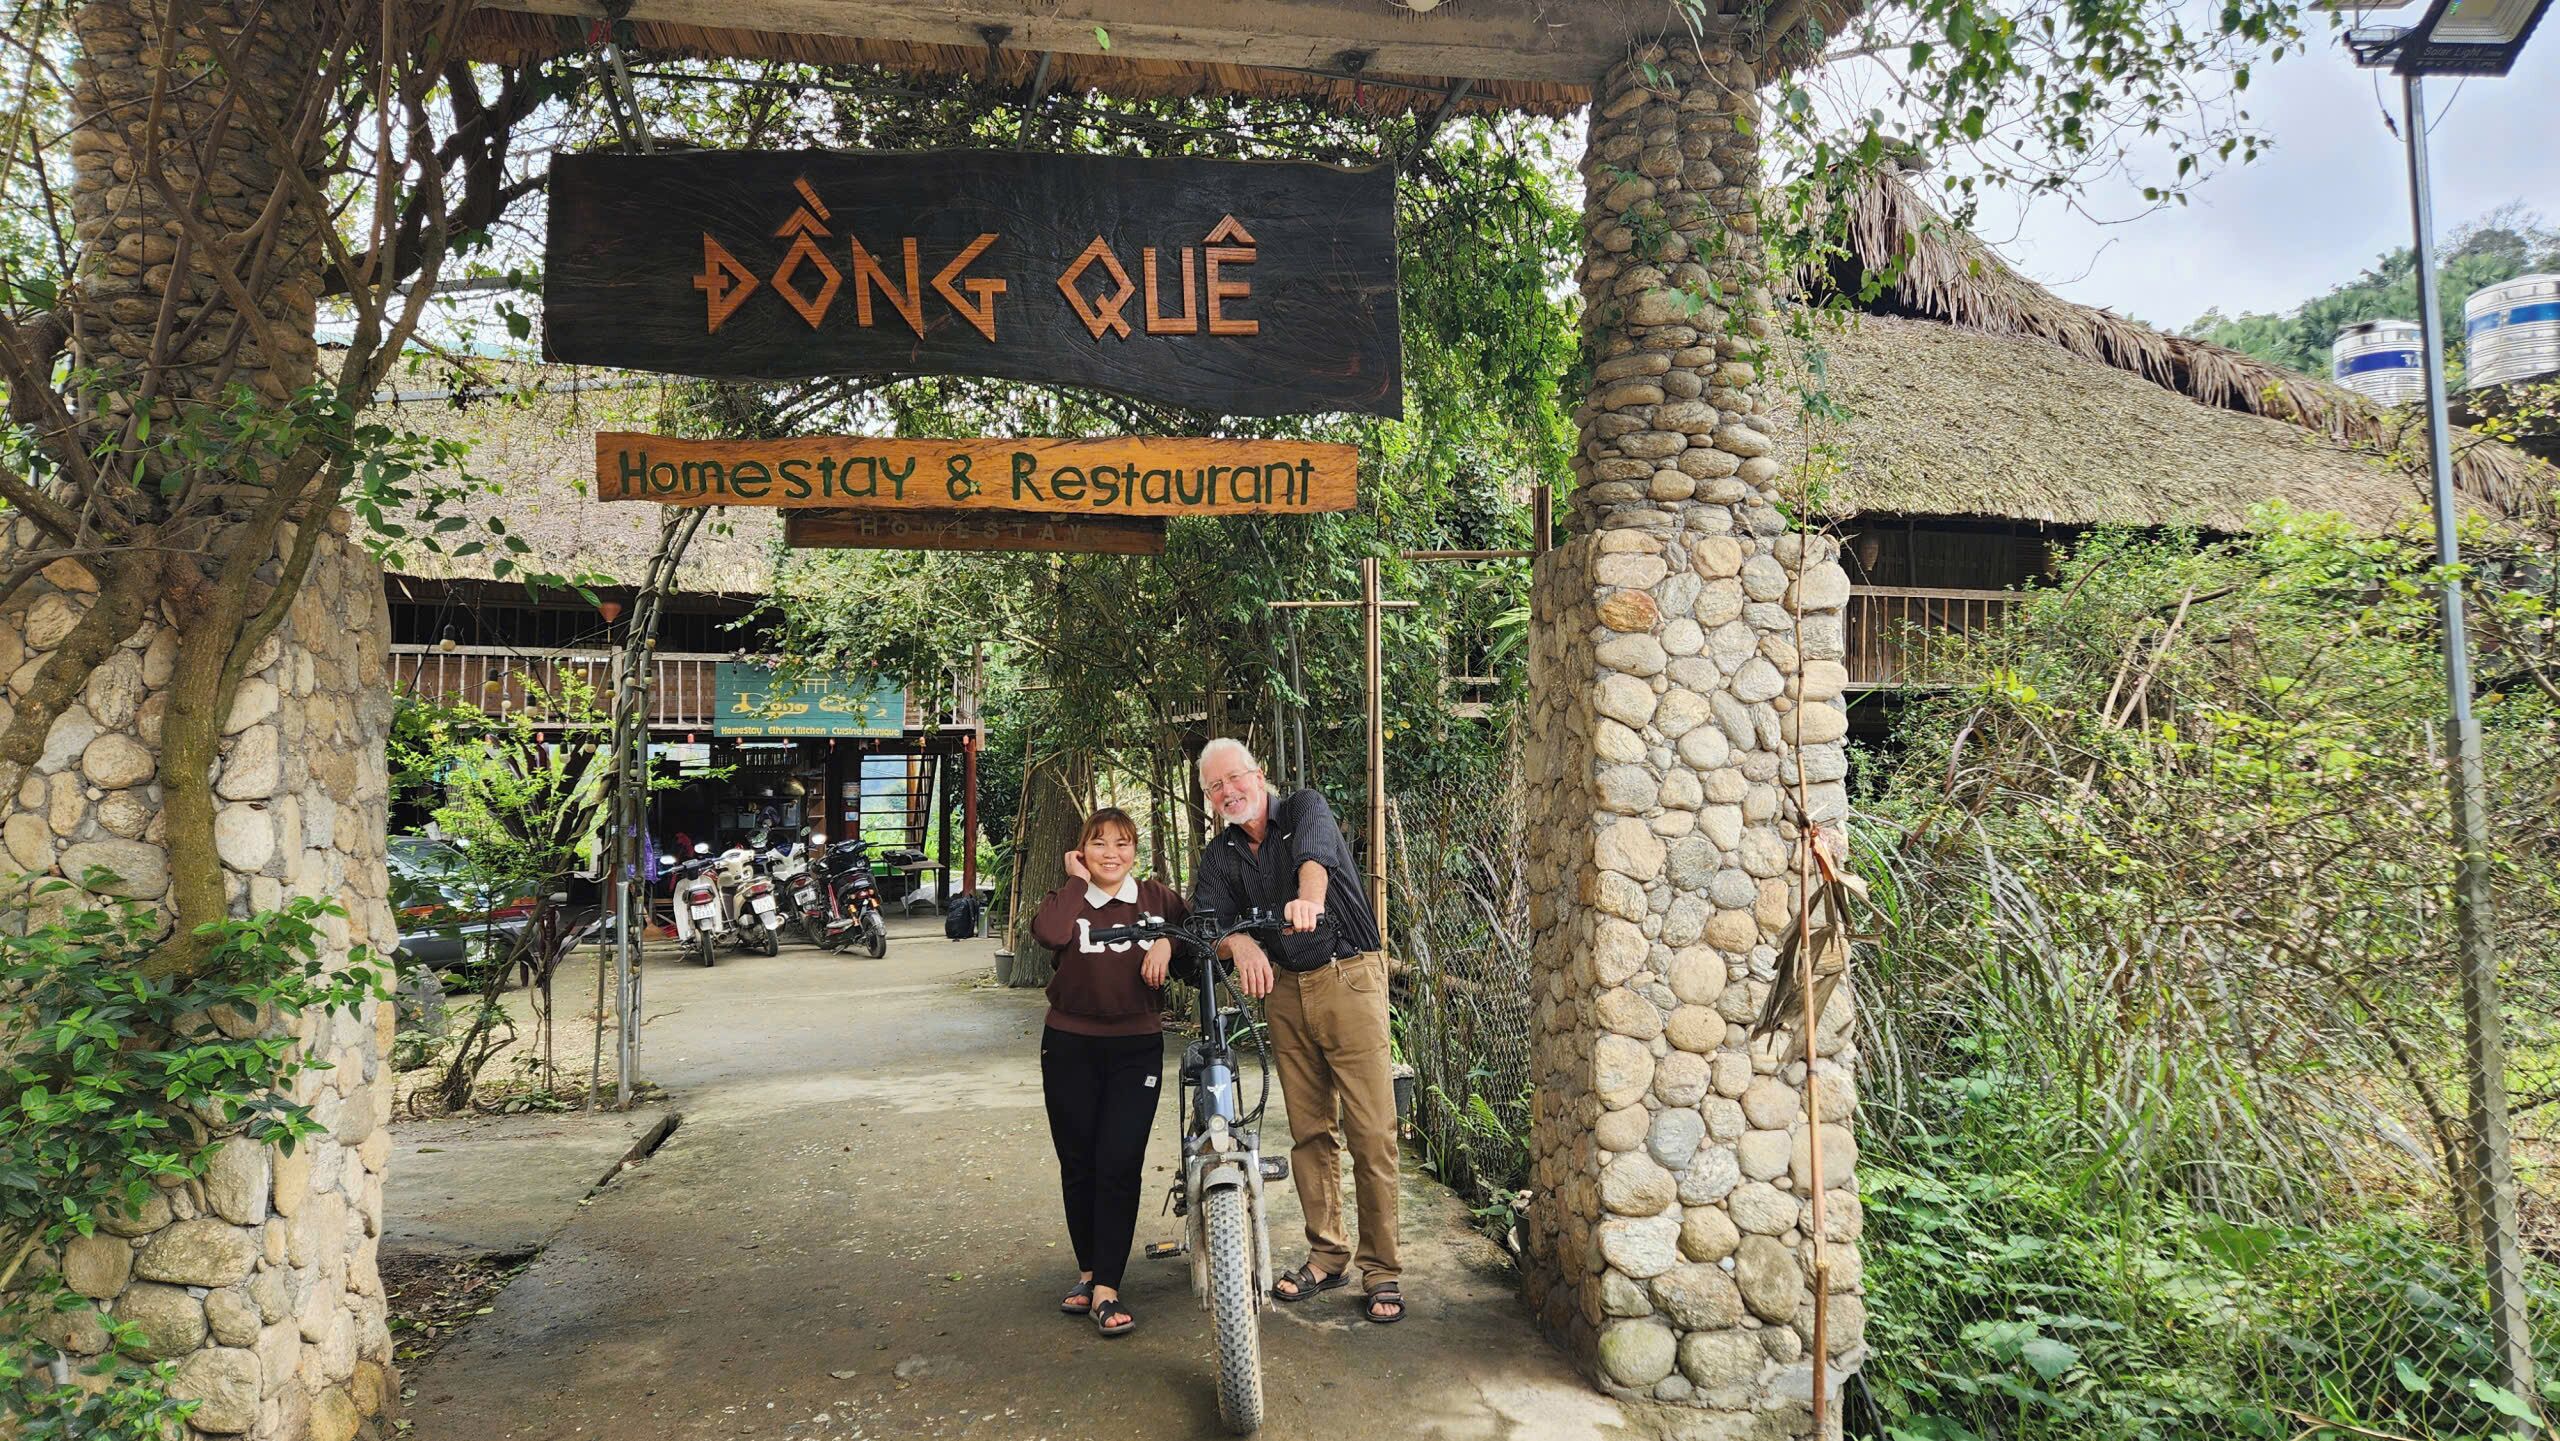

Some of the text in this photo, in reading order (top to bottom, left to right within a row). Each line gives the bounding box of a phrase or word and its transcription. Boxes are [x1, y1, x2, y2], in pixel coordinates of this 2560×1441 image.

[693, 178, 1260, 342] ĐỒNG QUÊ
[619, 450, 1316, 506] Homestay & Restaurant
[860, 518, 1081, 542] HOMESTAY
[831, 727, 863, 735] Cuisine
